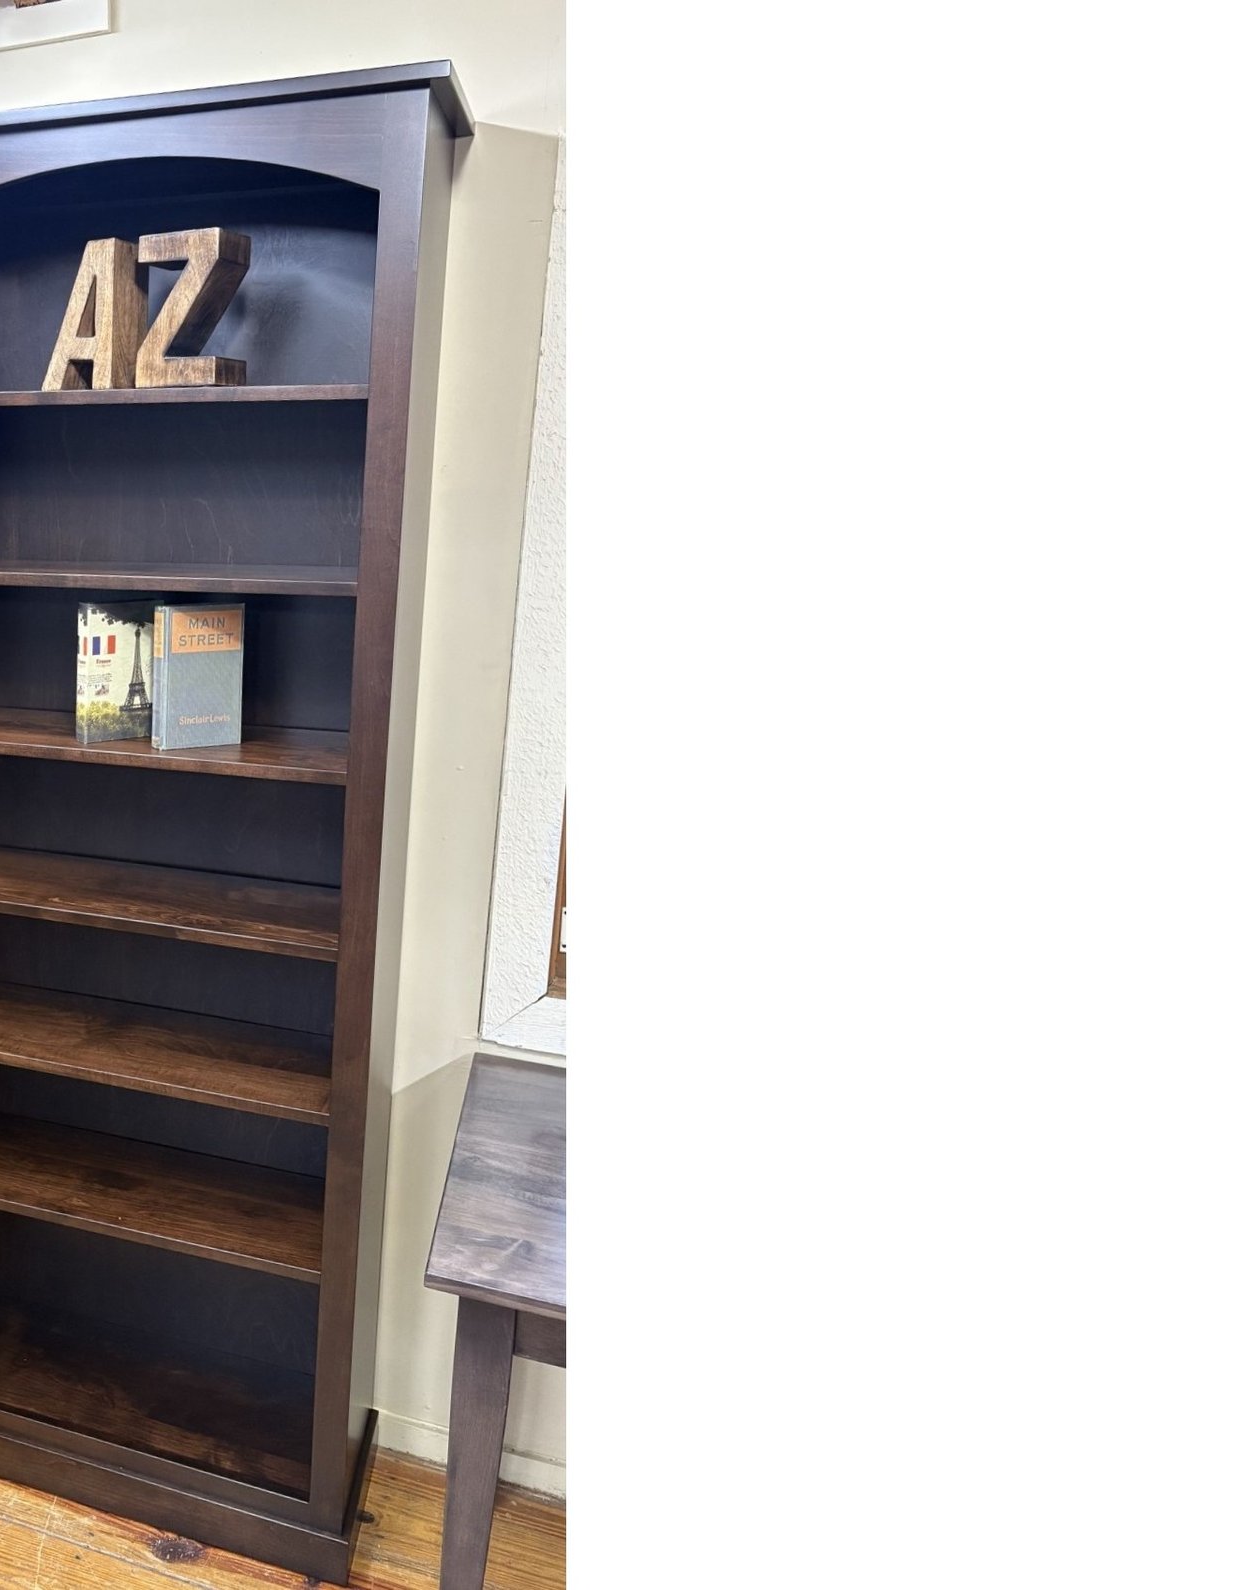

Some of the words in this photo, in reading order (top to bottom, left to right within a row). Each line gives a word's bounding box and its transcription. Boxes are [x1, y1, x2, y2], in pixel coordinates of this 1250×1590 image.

[188, 616, 226, 630] MAIN
[178, 632, 234, 647] STREET
[178, 714, 209, 726] Sinclair
[210, 712, 230, 723] Lewis
